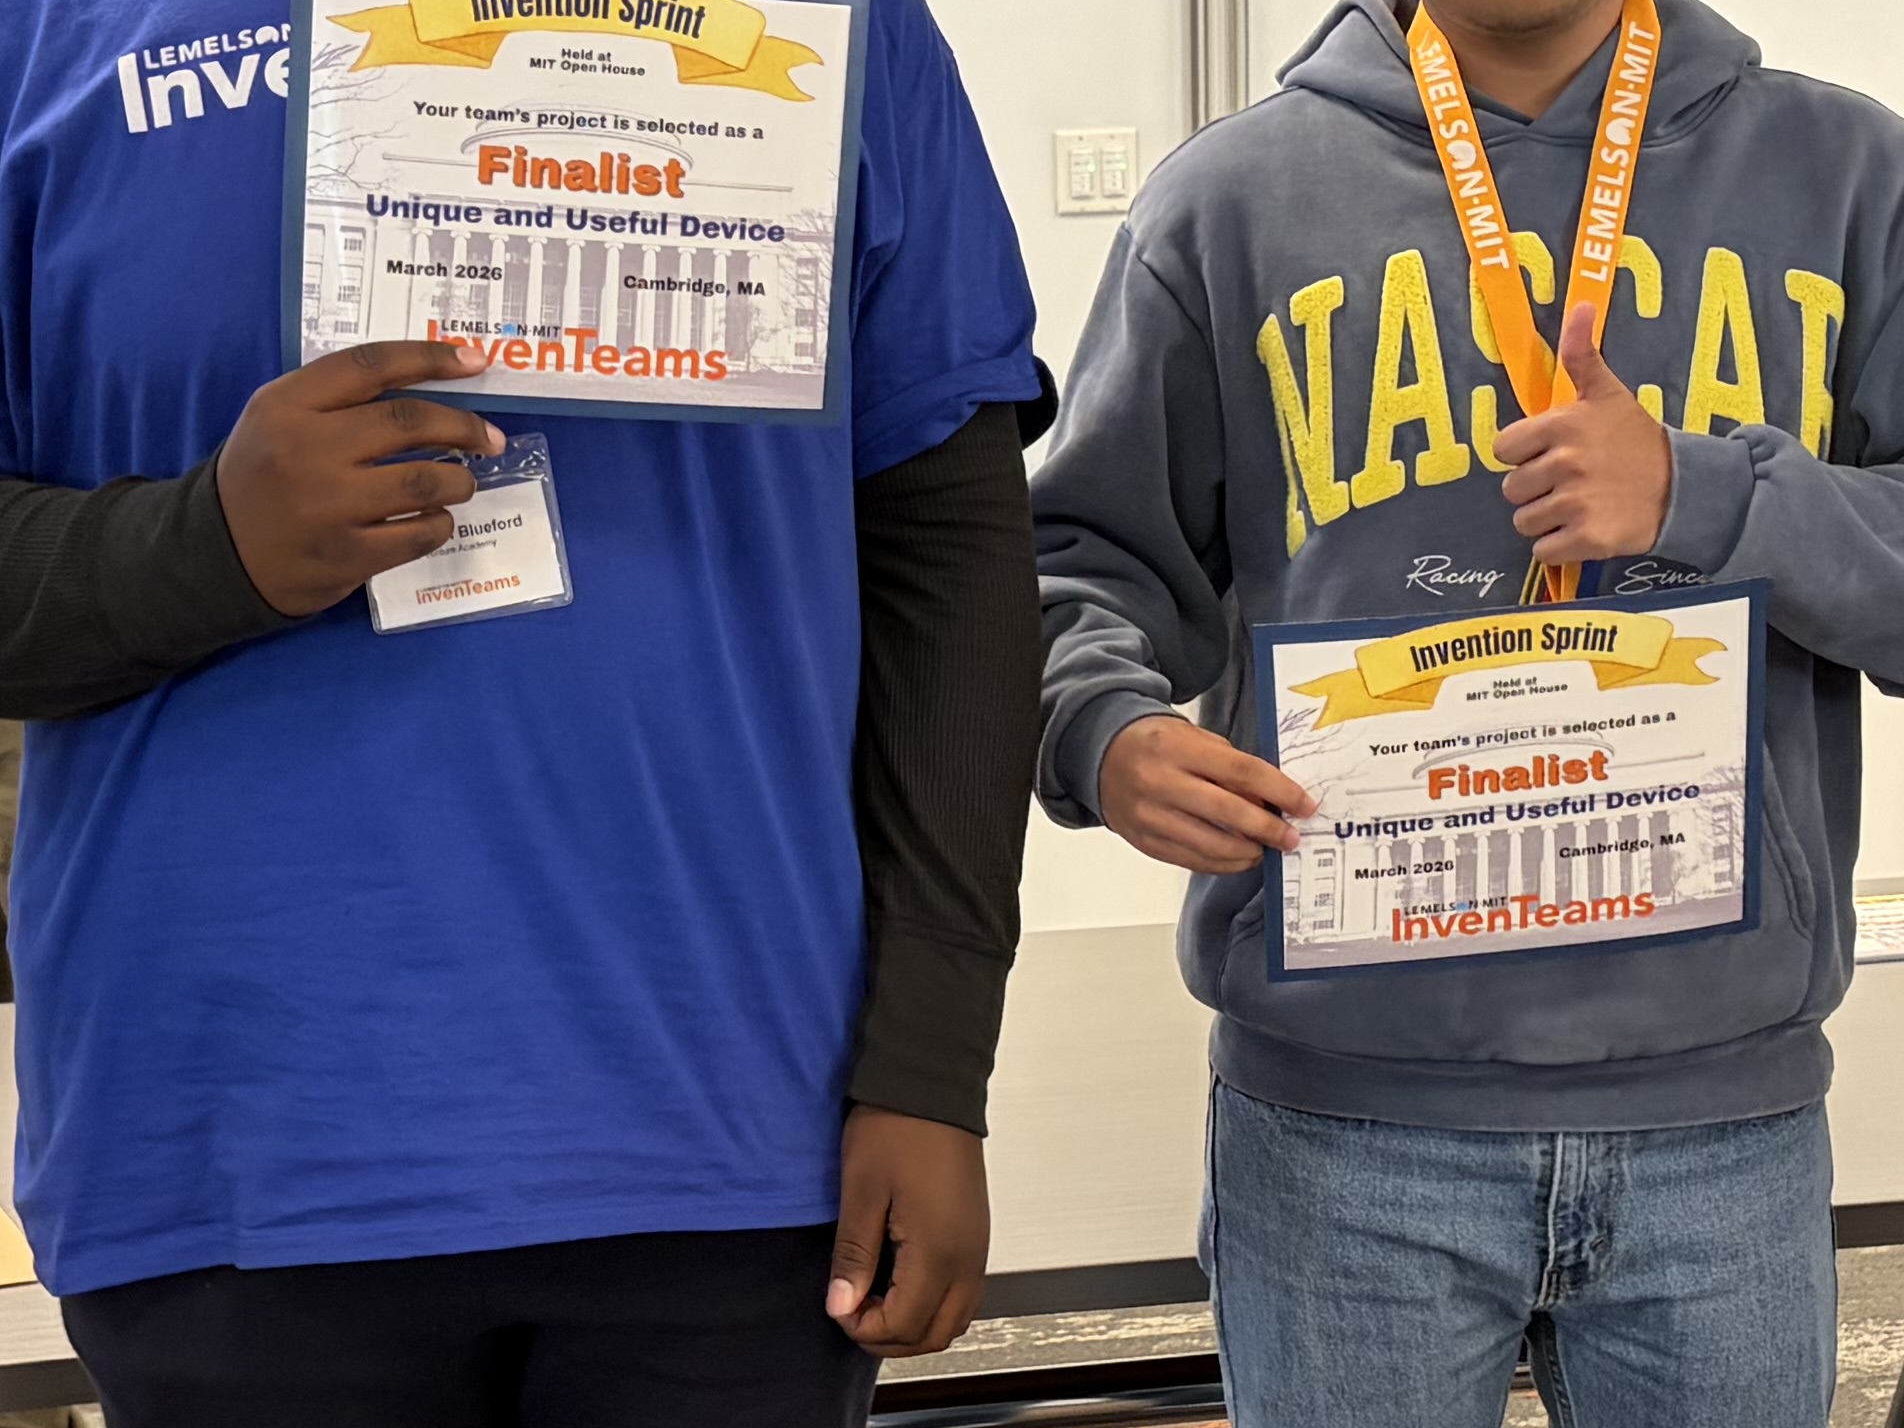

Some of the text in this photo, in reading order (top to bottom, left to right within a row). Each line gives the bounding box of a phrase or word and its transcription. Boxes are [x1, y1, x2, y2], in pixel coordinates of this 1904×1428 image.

[529, 58, 645, 76] MIT Open House
[561, 48, 610, 61] Held at
[414, 101, 764, 140] Your team's project is selected as a
[477, 144, 686, 199] Finalist
[366, 194, 786, 243] Unique and Useful Device
[387, 260, 766, 298] March 2026 Cambridge, MA
[458, 515, 522, 538] Blueford
[416, 575, 520, 604] InvenTeams
[1406, 555, 1505, 597] Racing
[1410, 622, 1618, 672] Invention Sprint
[1466, 683, 1568, 701] MIT Open House
[1493, 677, 1522, 688] Held
[1369, 711, 1676, 756] Your team's project is selected as a
[1428, 750, 1609, 800] Finalist
[1335, 784, 1700, 839] Unique and Useful Device
[1355, 833, 1685, 880] March 2026 Cambridge, MA
[1392, 892, 1655, 942] InvenTeams
